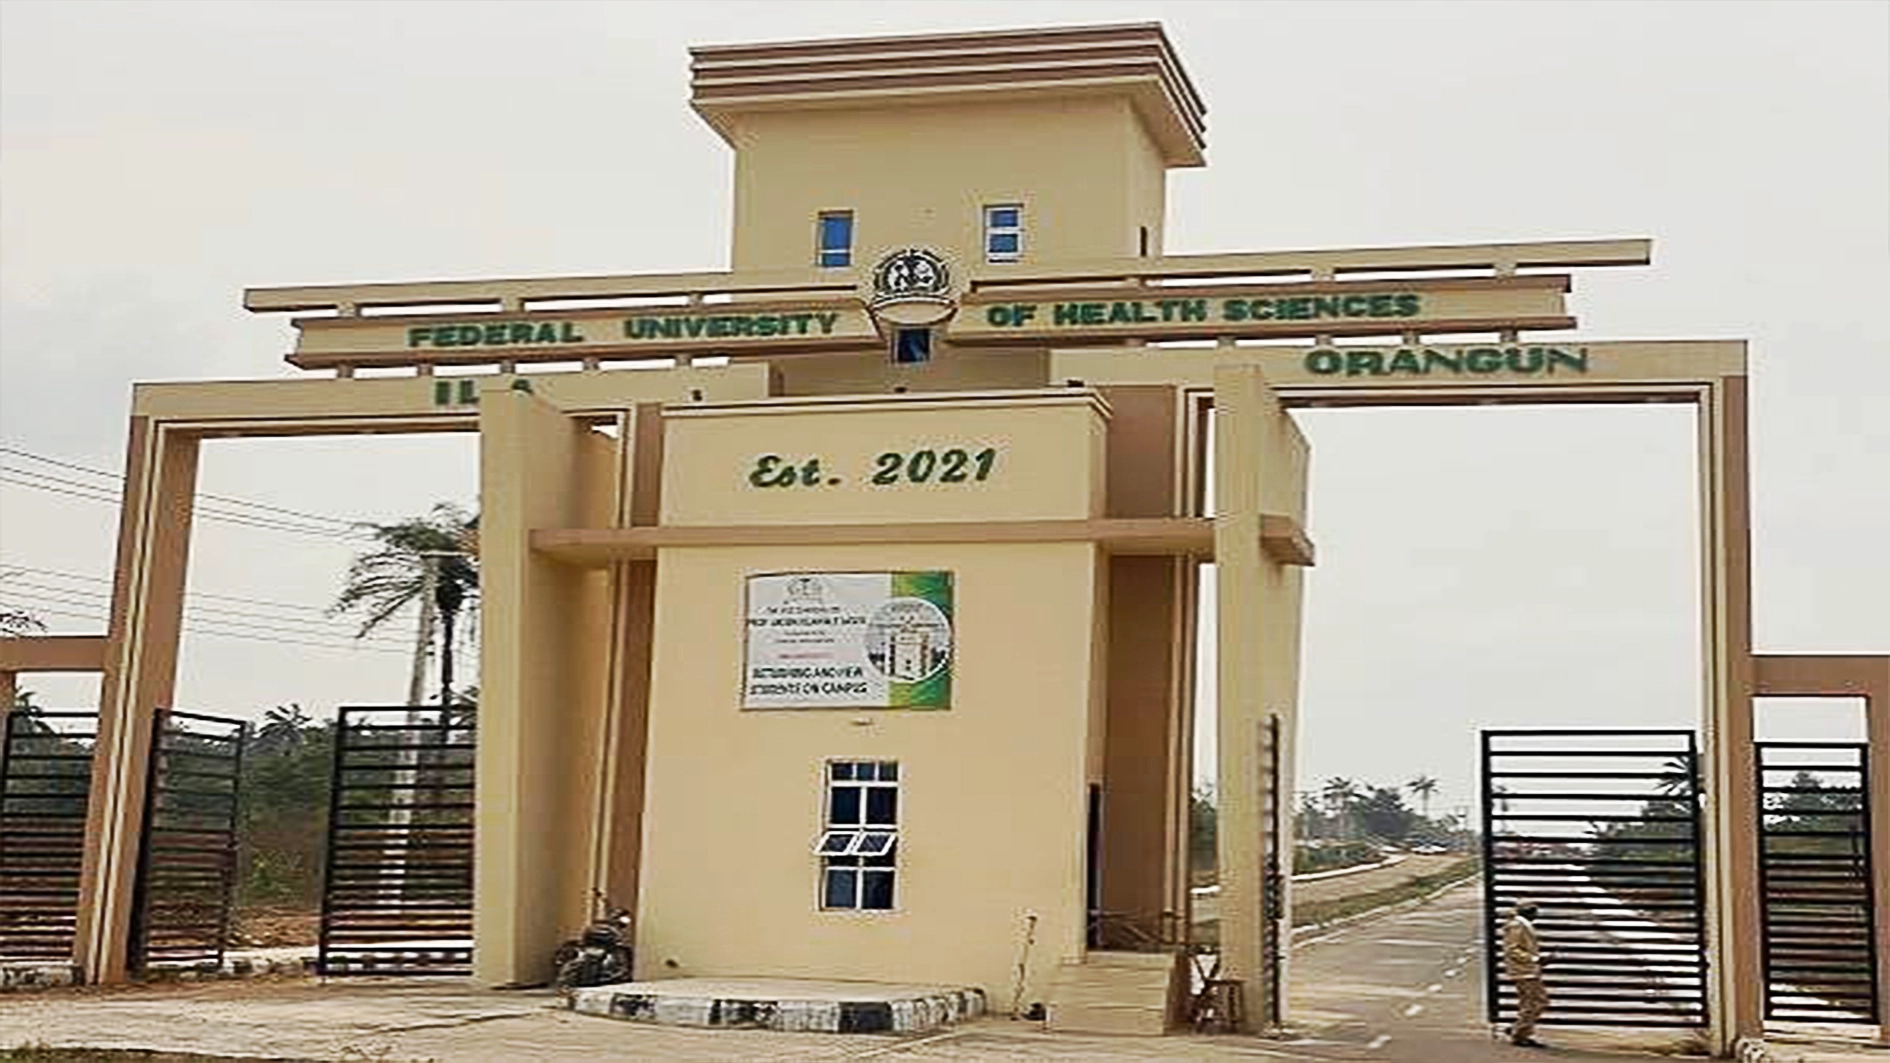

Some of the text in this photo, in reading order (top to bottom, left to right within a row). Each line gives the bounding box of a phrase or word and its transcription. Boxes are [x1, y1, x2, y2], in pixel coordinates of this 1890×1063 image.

[408, 295, 1420, 347] FEDERAL UNIVERSITY OF HEALTH SCIENCES
[1304, 347, 1588, 376] ORANGUN
[749, 448, 997, 488] Est. 2021
